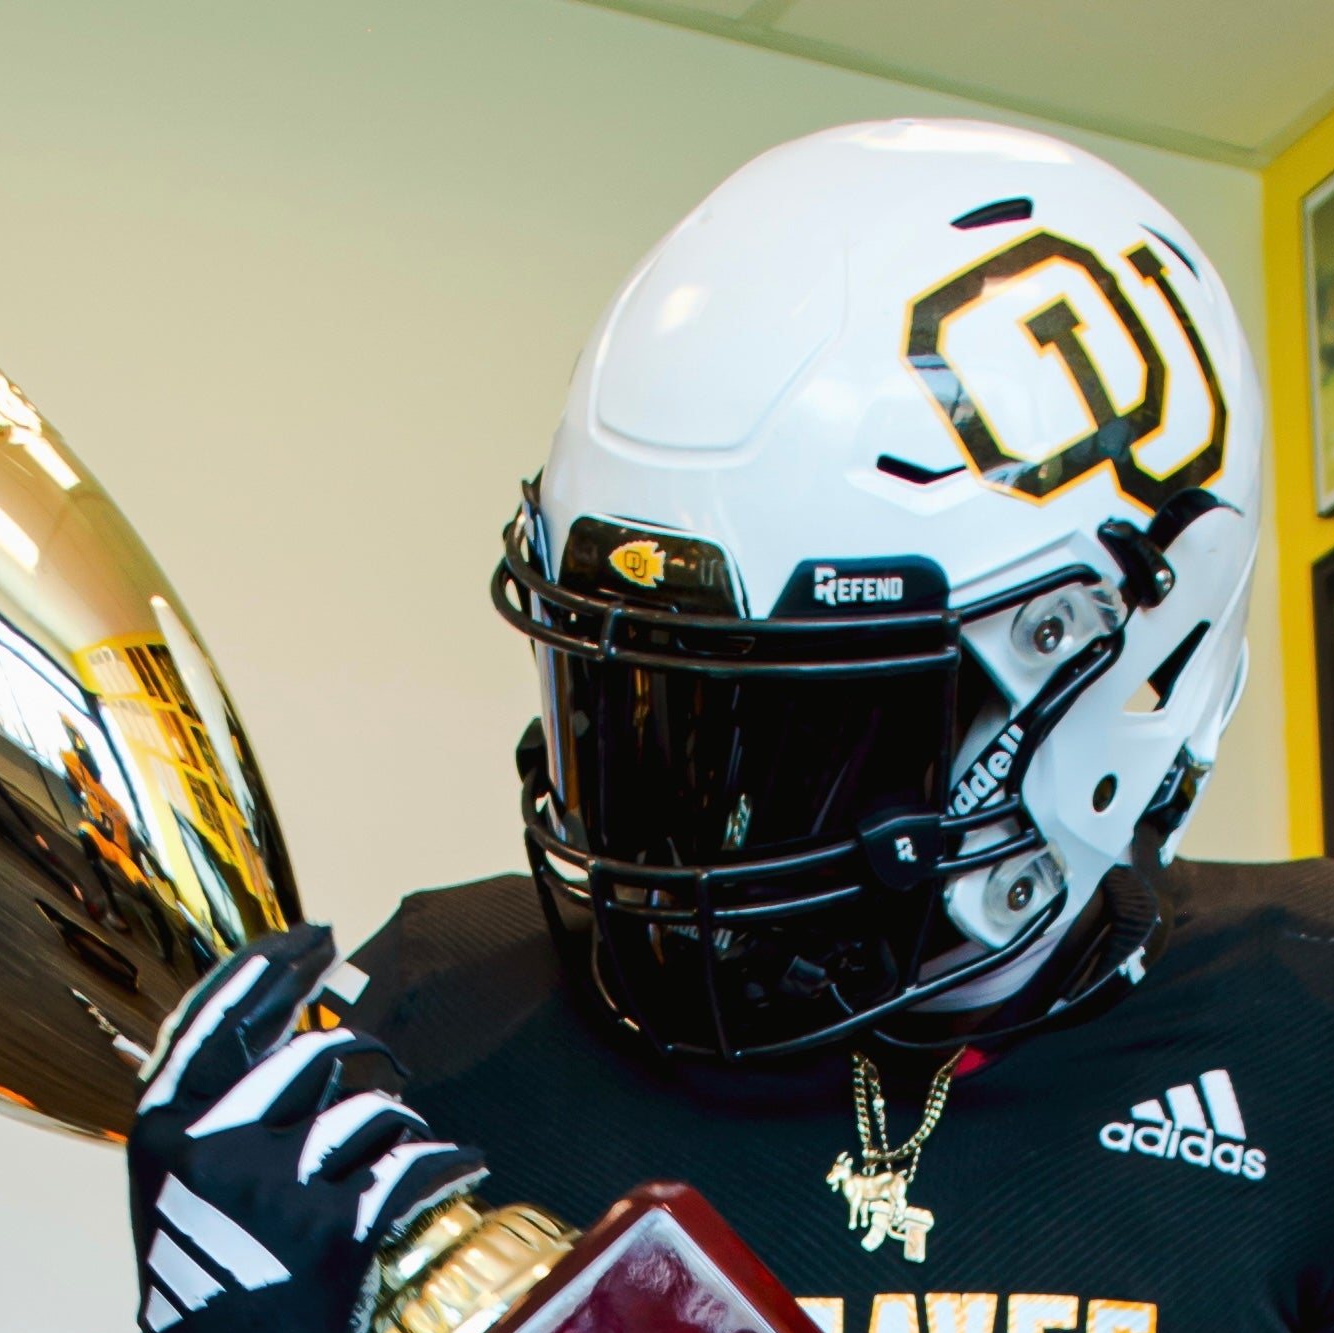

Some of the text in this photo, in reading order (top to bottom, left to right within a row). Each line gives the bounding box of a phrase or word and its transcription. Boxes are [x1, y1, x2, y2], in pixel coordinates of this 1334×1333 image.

[814, 566, 903, 607] REFEND
[947, 723, 1024, 817] ddell
[1099, 1119, 1267, 1181] adidas
